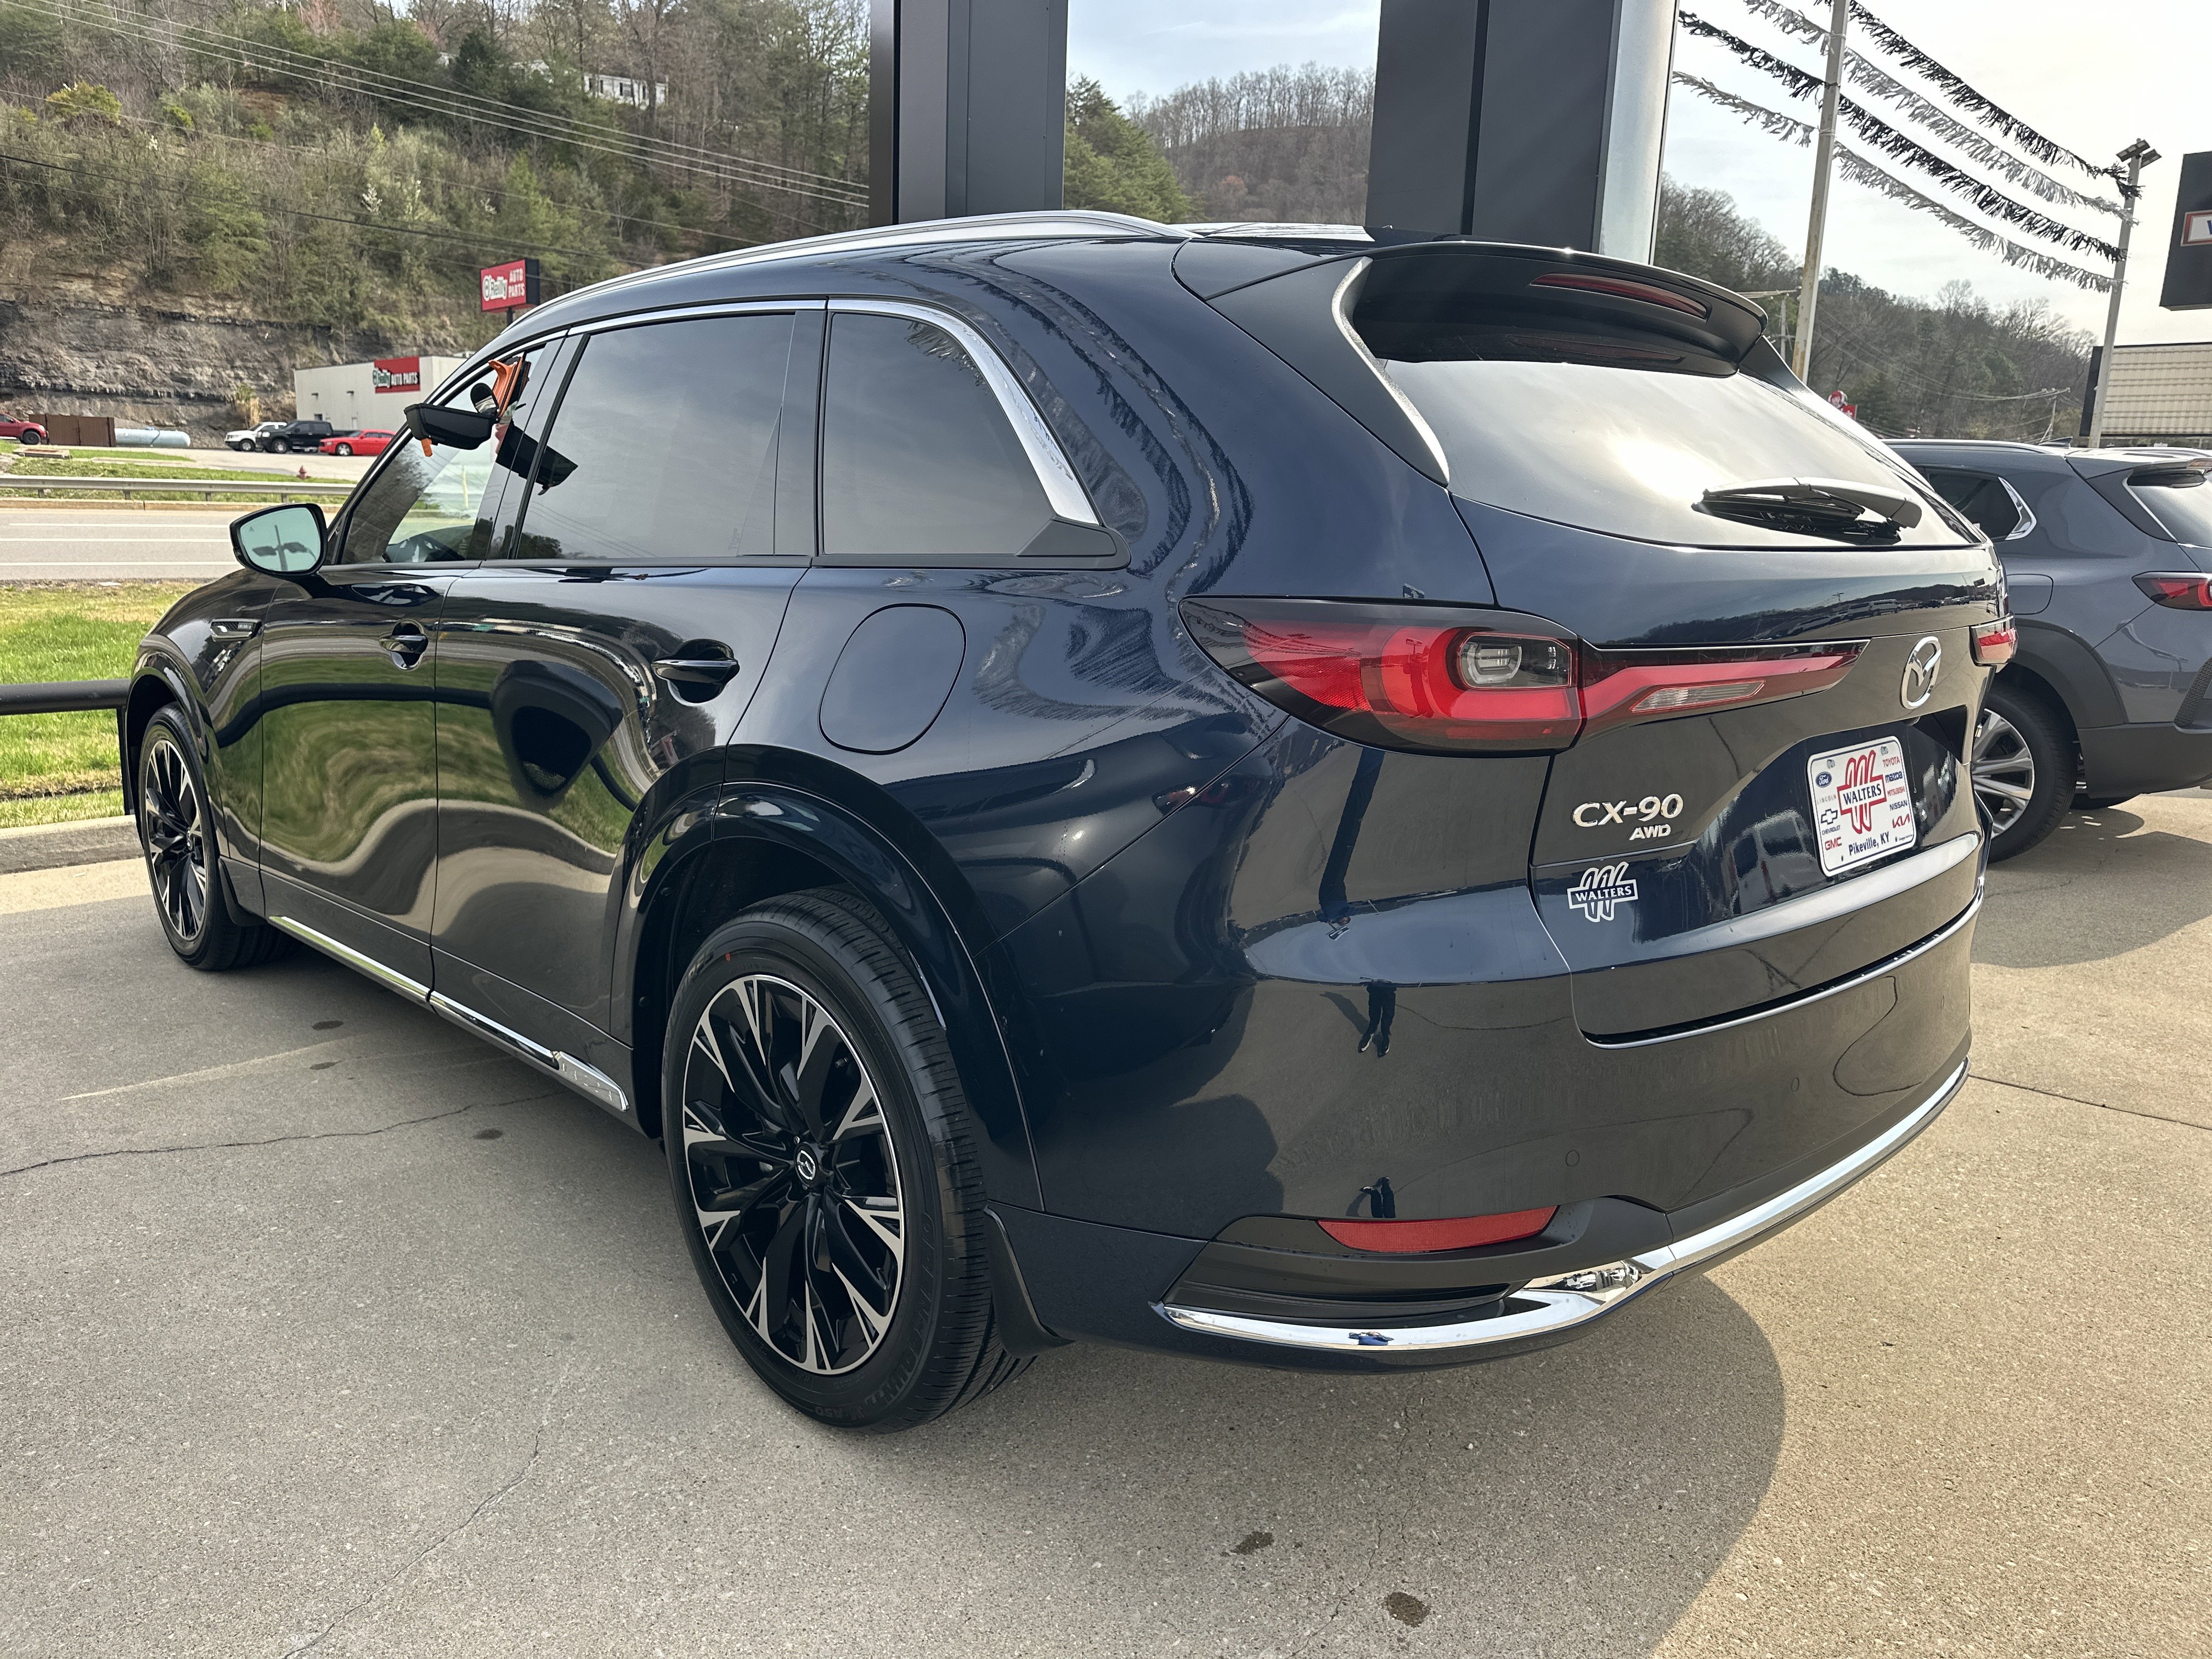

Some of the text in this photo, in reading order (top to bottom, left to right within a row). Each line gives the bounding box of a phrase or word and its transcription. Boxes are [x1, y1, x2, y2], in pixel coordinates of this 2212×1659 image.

[509, 268, 523, 283] AUTO
[483, 274, 508, 302] O'Reilly
[508, 283, 525, 298] PARTS
[391, 373, 402, 386] AUTO
[403, 371, 418, 385] PARTS
[1883, 756, 1900, 768] TOYOTA
[1843, 783, 1882, 805] WALTERS
[1887, 786, 1905, 797] MITSUBISHI
[1816, 794, 1837, 805] LINCOLN
[1889, 799, 1908, 811] NISSAN
[1572, 793, 1684, 827] CX-90
[1628, 824, 1671, 840] AWD
[1822, 825, 1841, 835] CHEVROLET
[1825, 837, 1842, 850] GMC
[1848, 837, 1879, 856] Pikeville,
[1880, 831, 1889, 845] KY
[1575, 885, 1632, 902] WALTERS
